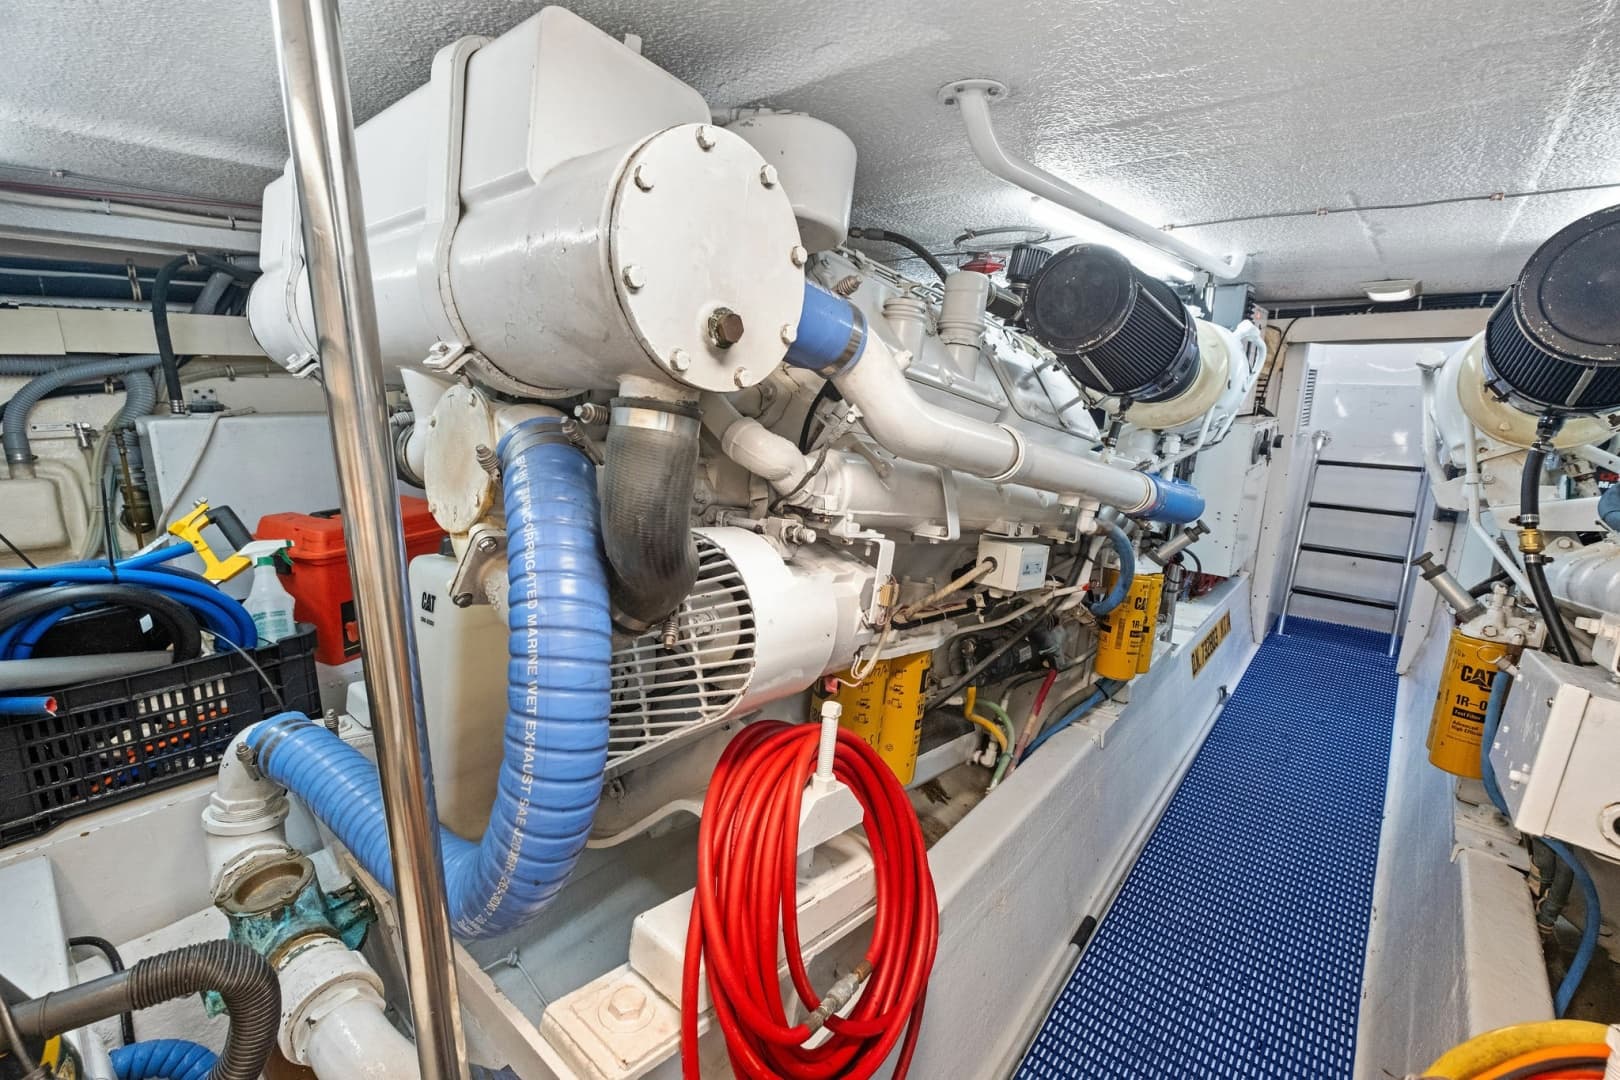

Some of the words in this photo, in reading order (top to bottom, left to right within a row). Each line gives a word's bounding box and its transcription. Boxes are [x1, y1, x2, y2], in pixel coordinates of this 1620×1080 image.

[421, 591, 436, 614] CAT
[1134, 597, 1147, 610] CA
[526, 614, 538, 675] MARINE
[1460, 665, 1497, 690] CAT
[526, 680, 538, 715] WET
[520, 720, 537, 795] EXHAUST
[515, 798, 530, 827] SAE
